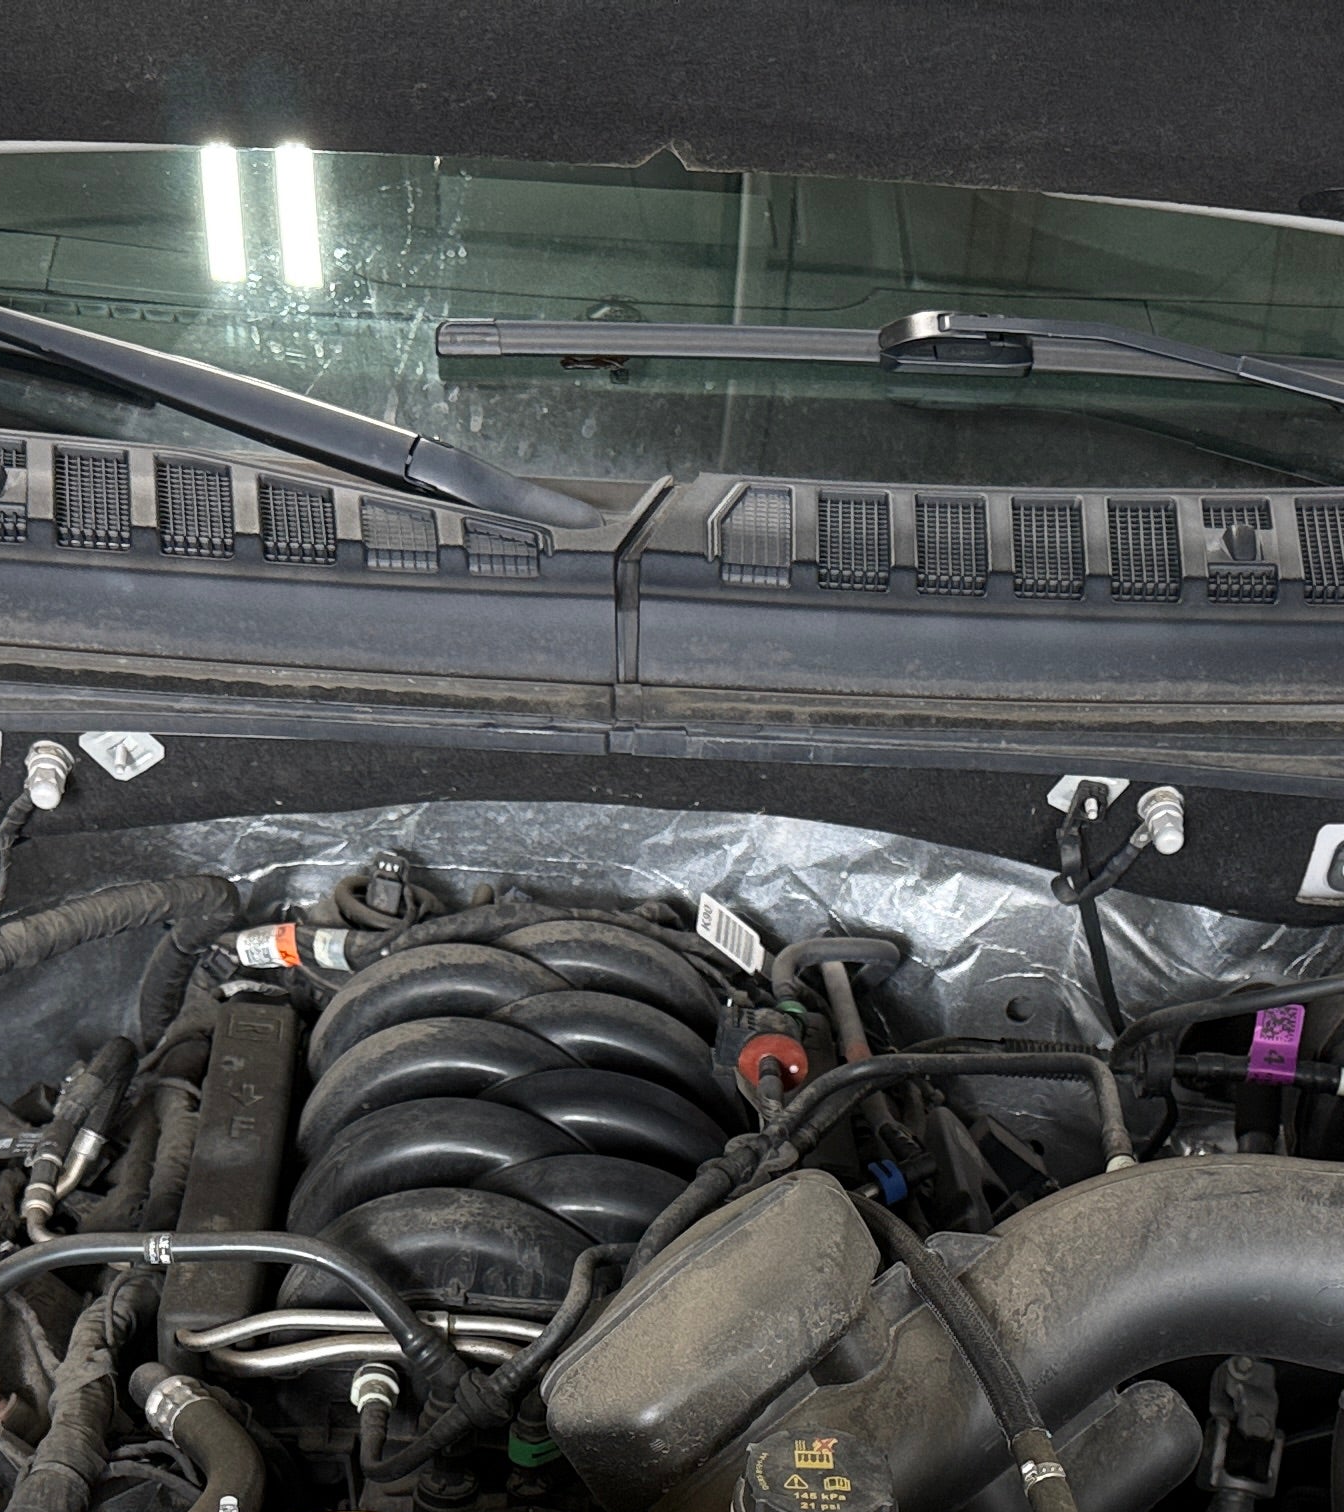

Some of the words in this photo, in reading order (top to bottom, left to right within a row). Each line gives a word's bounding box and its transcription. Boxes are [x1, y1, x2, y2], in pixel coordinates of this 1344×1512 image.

[701, 904, 713, 932] K90
[793, 1492, 817, 1500] 145
[821, 1493, 847, 1501] kPa
[800, 1502, 816, 1510] 21
[820, 1503, 841, 1512] psi
